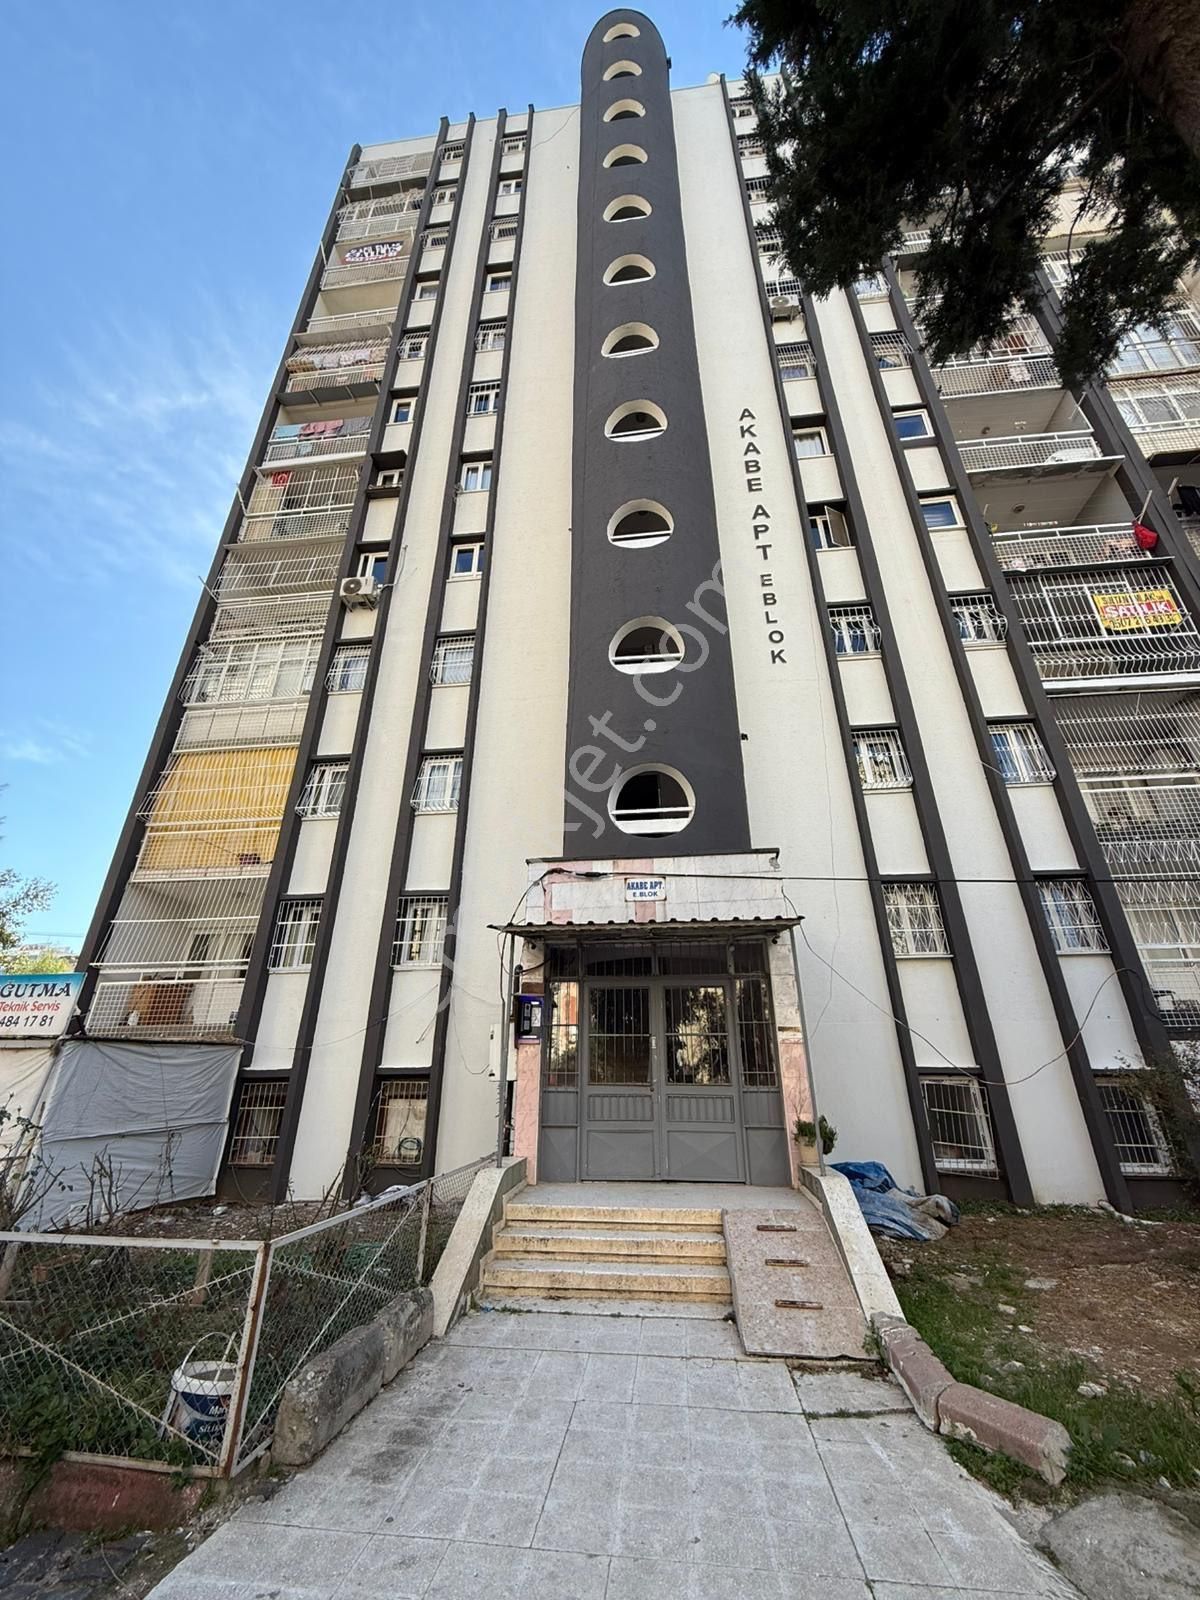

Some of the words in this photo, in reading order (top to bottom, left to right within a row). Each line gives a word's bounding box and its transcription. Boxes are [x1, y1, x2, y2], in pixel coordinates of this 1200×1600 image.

[739, 408, 763, 492] AKABE
[752, 505, 773, 560] APT
[31, 1000, 61, 1011] Servis
[24, 1015, 39, 1026] 17
[40, 1015, 55, 1026] 81
